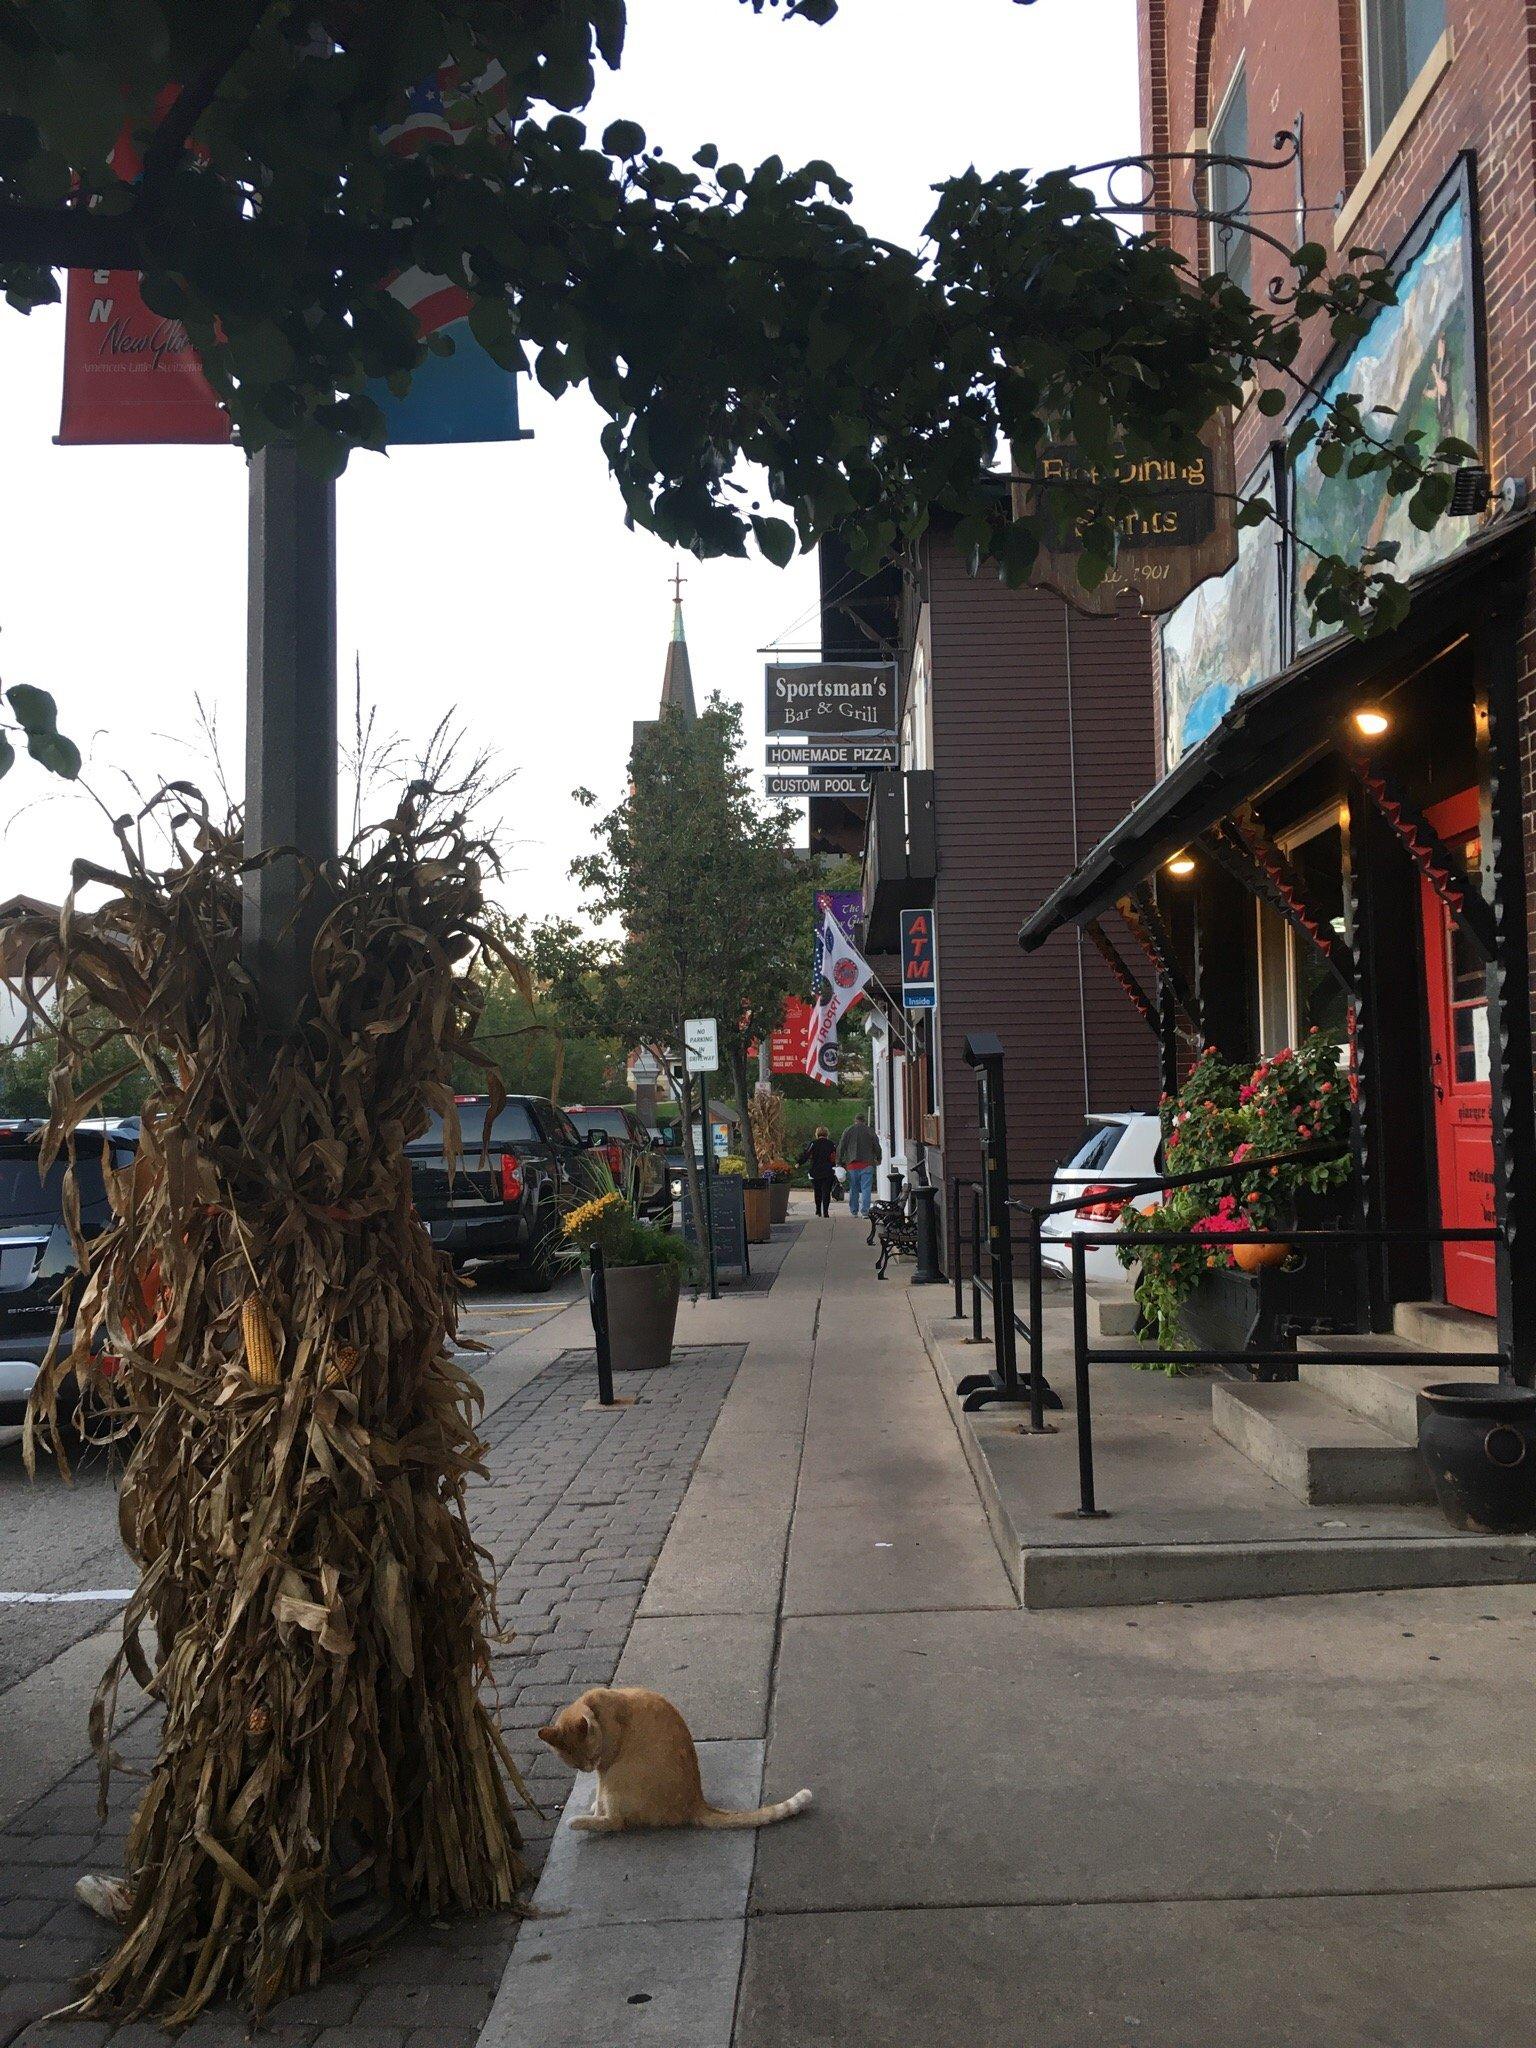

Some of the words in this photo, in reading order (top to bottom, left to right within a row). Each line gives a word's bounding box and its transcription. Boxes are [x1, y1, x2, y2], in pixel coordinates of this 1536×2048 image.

[776, 677, 887, 702] Sportsman's
[783, 707, 813, 724] Bar
[817, 701, 834, 715] &
[838, 702, 879, 724] Grill
[771, 748, 848, 762] HOMEMADE
[853, 748, 892, 762] PIZZA
[771, 779, 820, 792] CUSTOM
[824, 779, 857, 792] POOL
[841, 903, 860, 914] The
[906, 914, 931, 980] ATM
[908, 997, 931, 1006] Inside
[688, 1055, 715, 1063] DRIVEWAY
